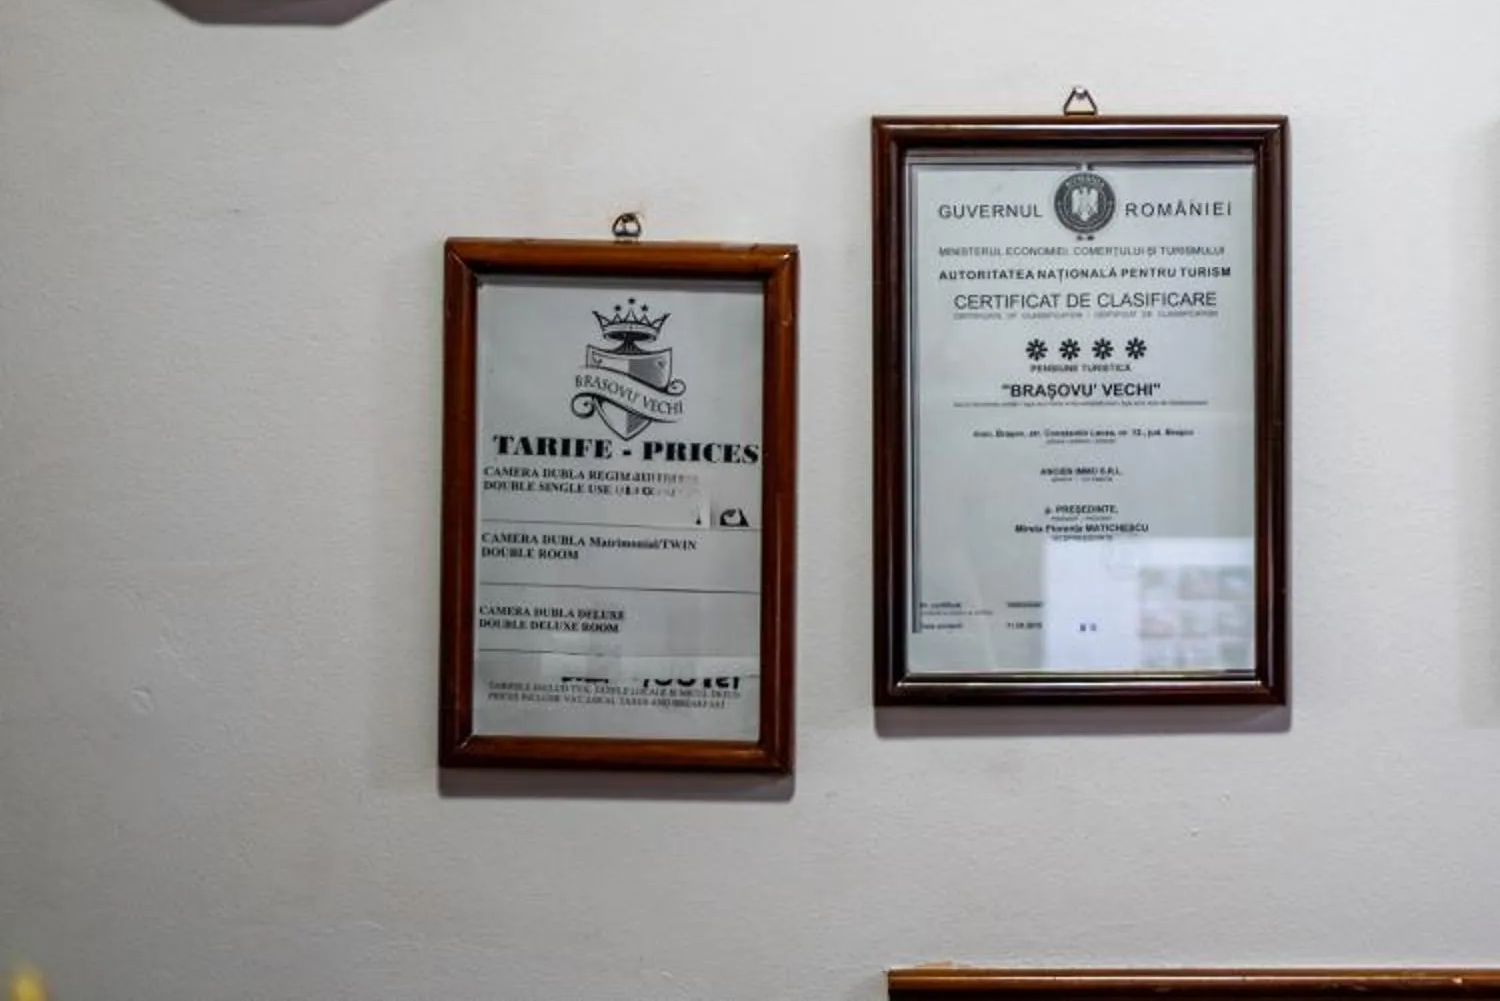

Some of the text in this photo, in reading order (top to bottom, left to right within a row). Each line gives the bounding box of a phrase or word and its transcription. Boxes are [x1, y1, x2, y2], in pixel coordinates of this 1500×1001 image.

[938, 200, 1232, 219] GUVERNUL ROMÂNIEI
[939, 269, 1035, 280] AUTORITATEA
[1121, 268, 1177, 278] PENTRU
[1181, 266, 1232, 278] TURISM
[953, 292, 1217, 310] CERTIFICAT DE CLASIFICARE
[643, 395, 683, 415] VECHI
[492, 434, 613, 459] TARIFE
[642, 441, 759, 464] PRICES
[483, 466, 540, 479] CAMERA
[542, 468, 585, 480] DUBLA
[483, 480, 537, 492] DOUBLE
[540, 482, 584, 494] SINGLE
[588, 484, 610, 495] USE
[481, 532, 538, 545] CAMERA
[542, 533, 585, 546] DUBLA
[481, 547, 579, 559] DOUBLE ROOM
[479, 605, 625, 620] CAMERA DUBLA DELUXE
[479, 619, 619, 633] DOUBLE DELUXE ROOM
